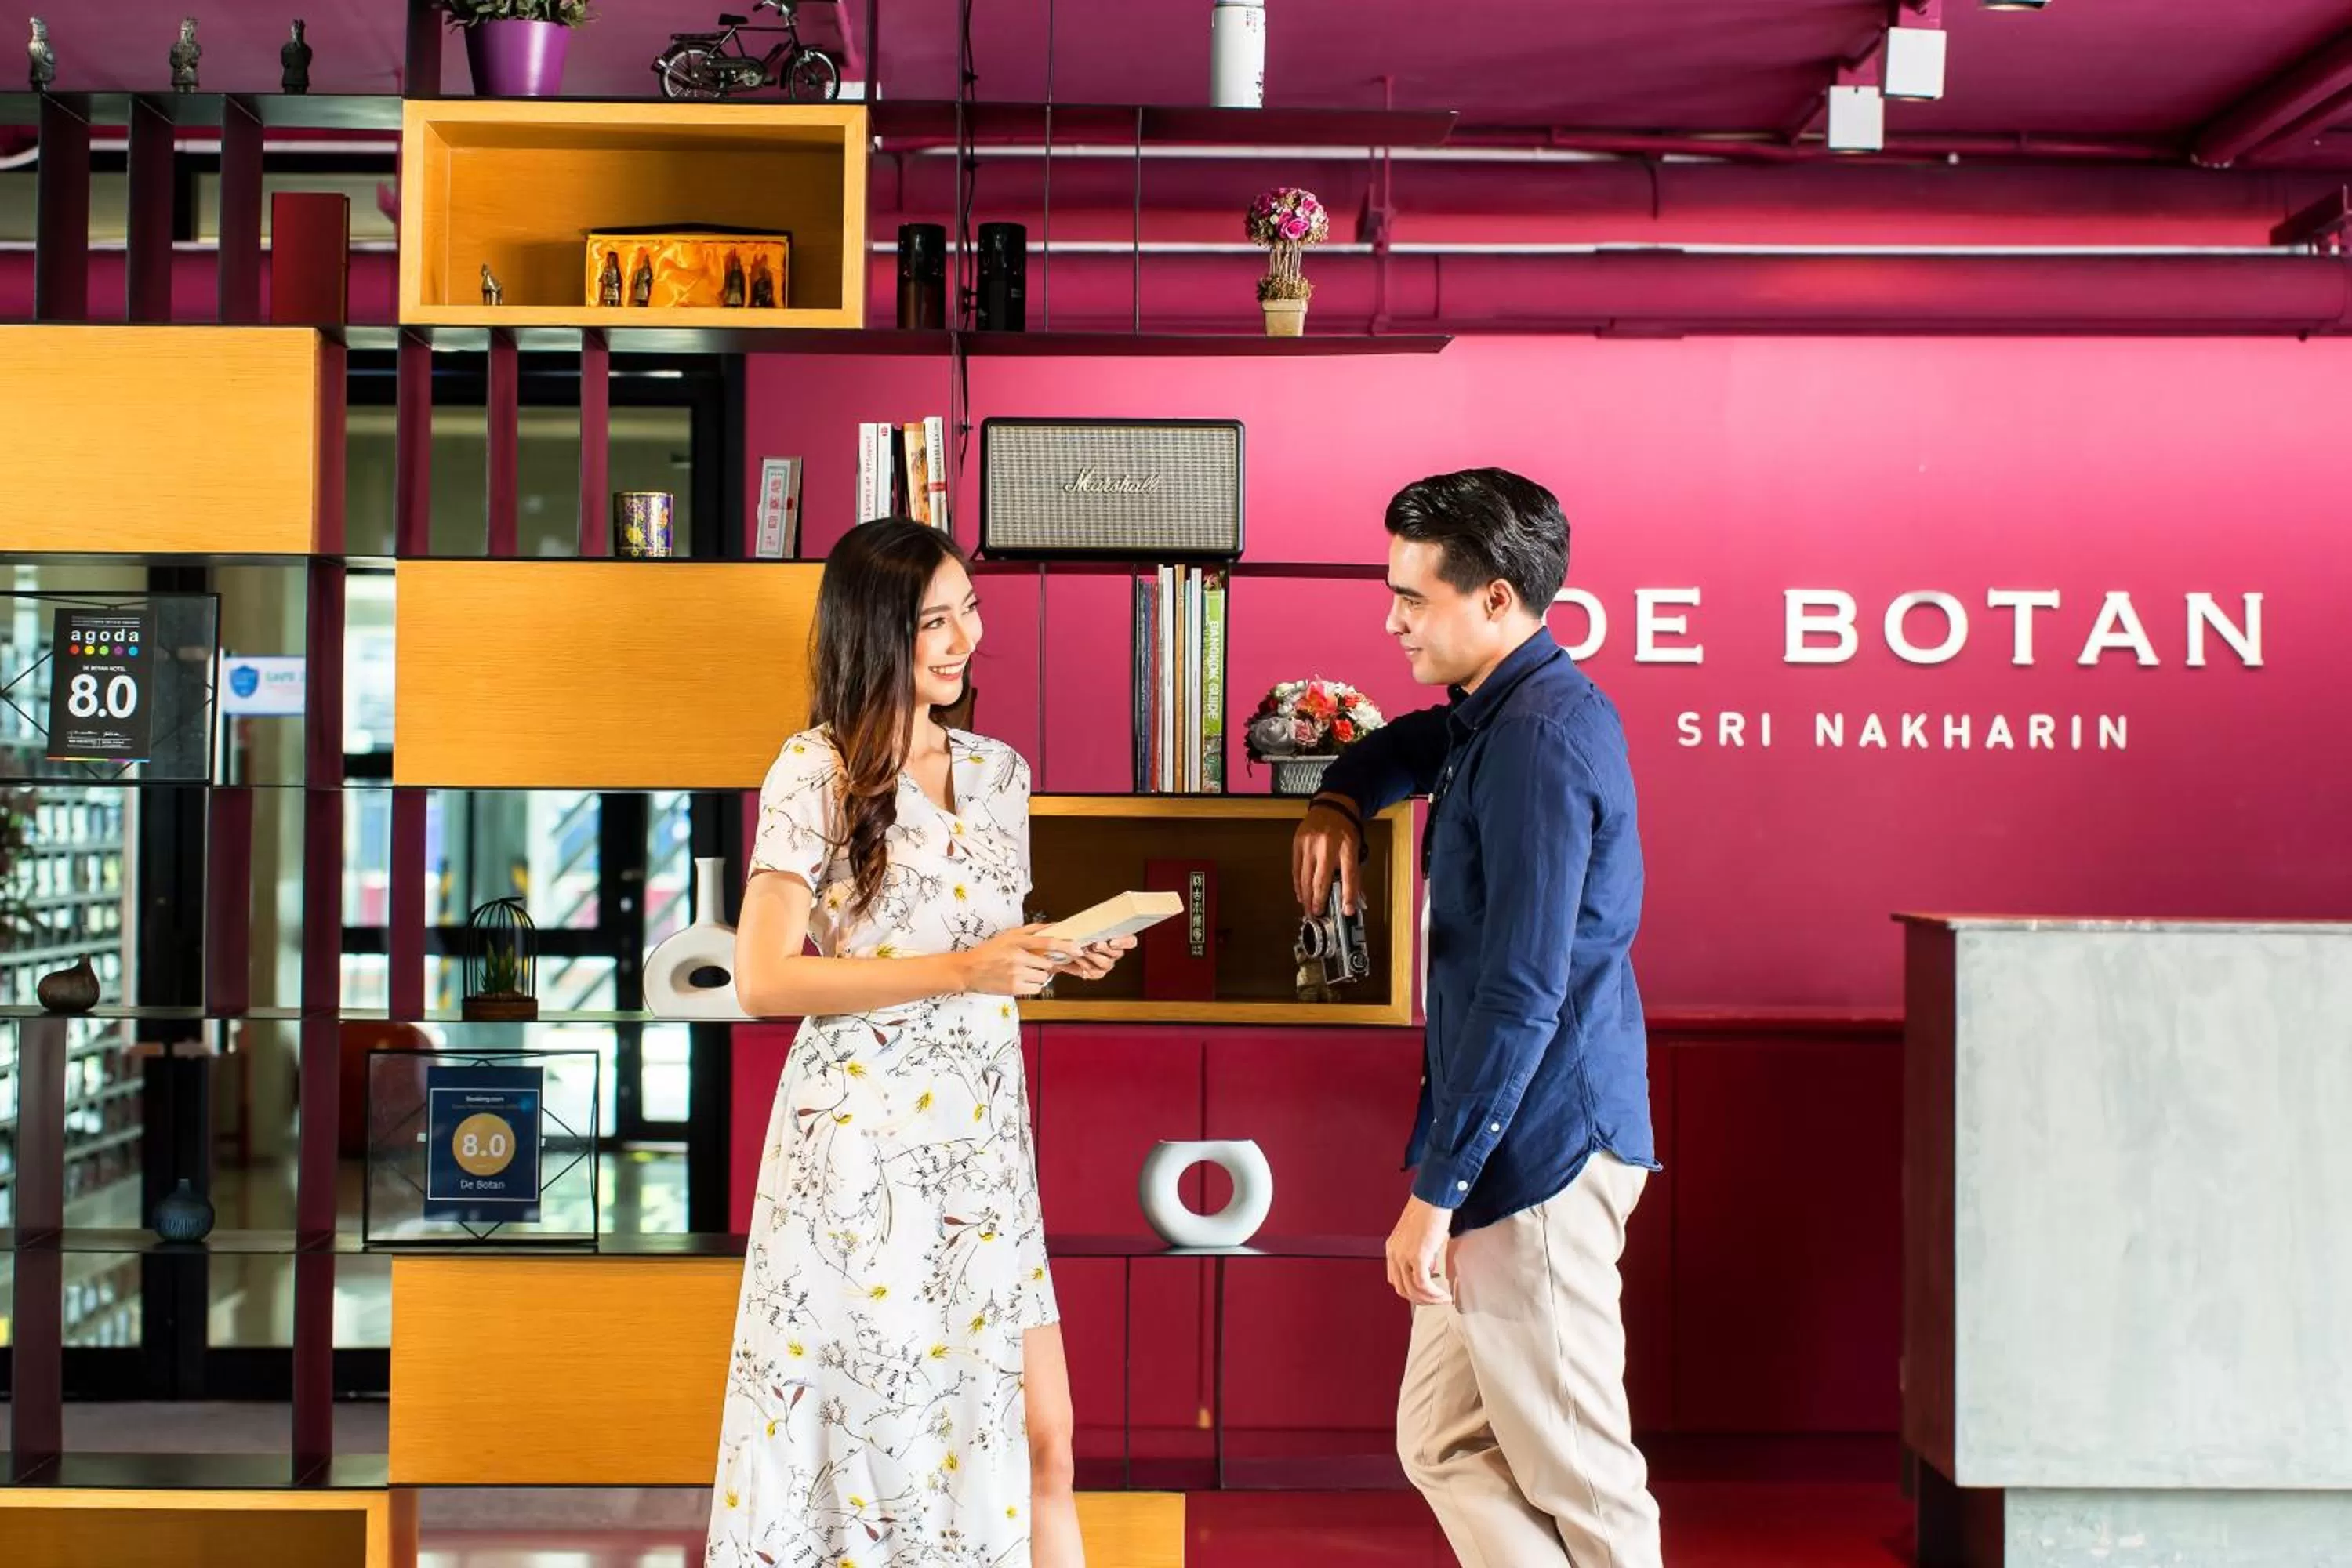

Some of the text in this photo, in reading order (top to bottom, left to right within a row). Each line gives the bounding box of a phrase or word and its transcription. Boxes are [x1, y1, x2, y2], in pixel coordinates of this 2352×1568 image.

[1063, 466, 1162, 495] Marshall
[71, 628, 139, 644] agoda
[1783, 588, 2263, 666] BOTAN
[1208, 620, 1220, 720] BANGKOK GUIDE
[68, 673, 137, 718] 8.0
[1677, 711, 2130, 750] SRI NAKHARIN
[462, 1134, 506, 1157] 8.0
[460, 1179, 506, 1190] De Botan
